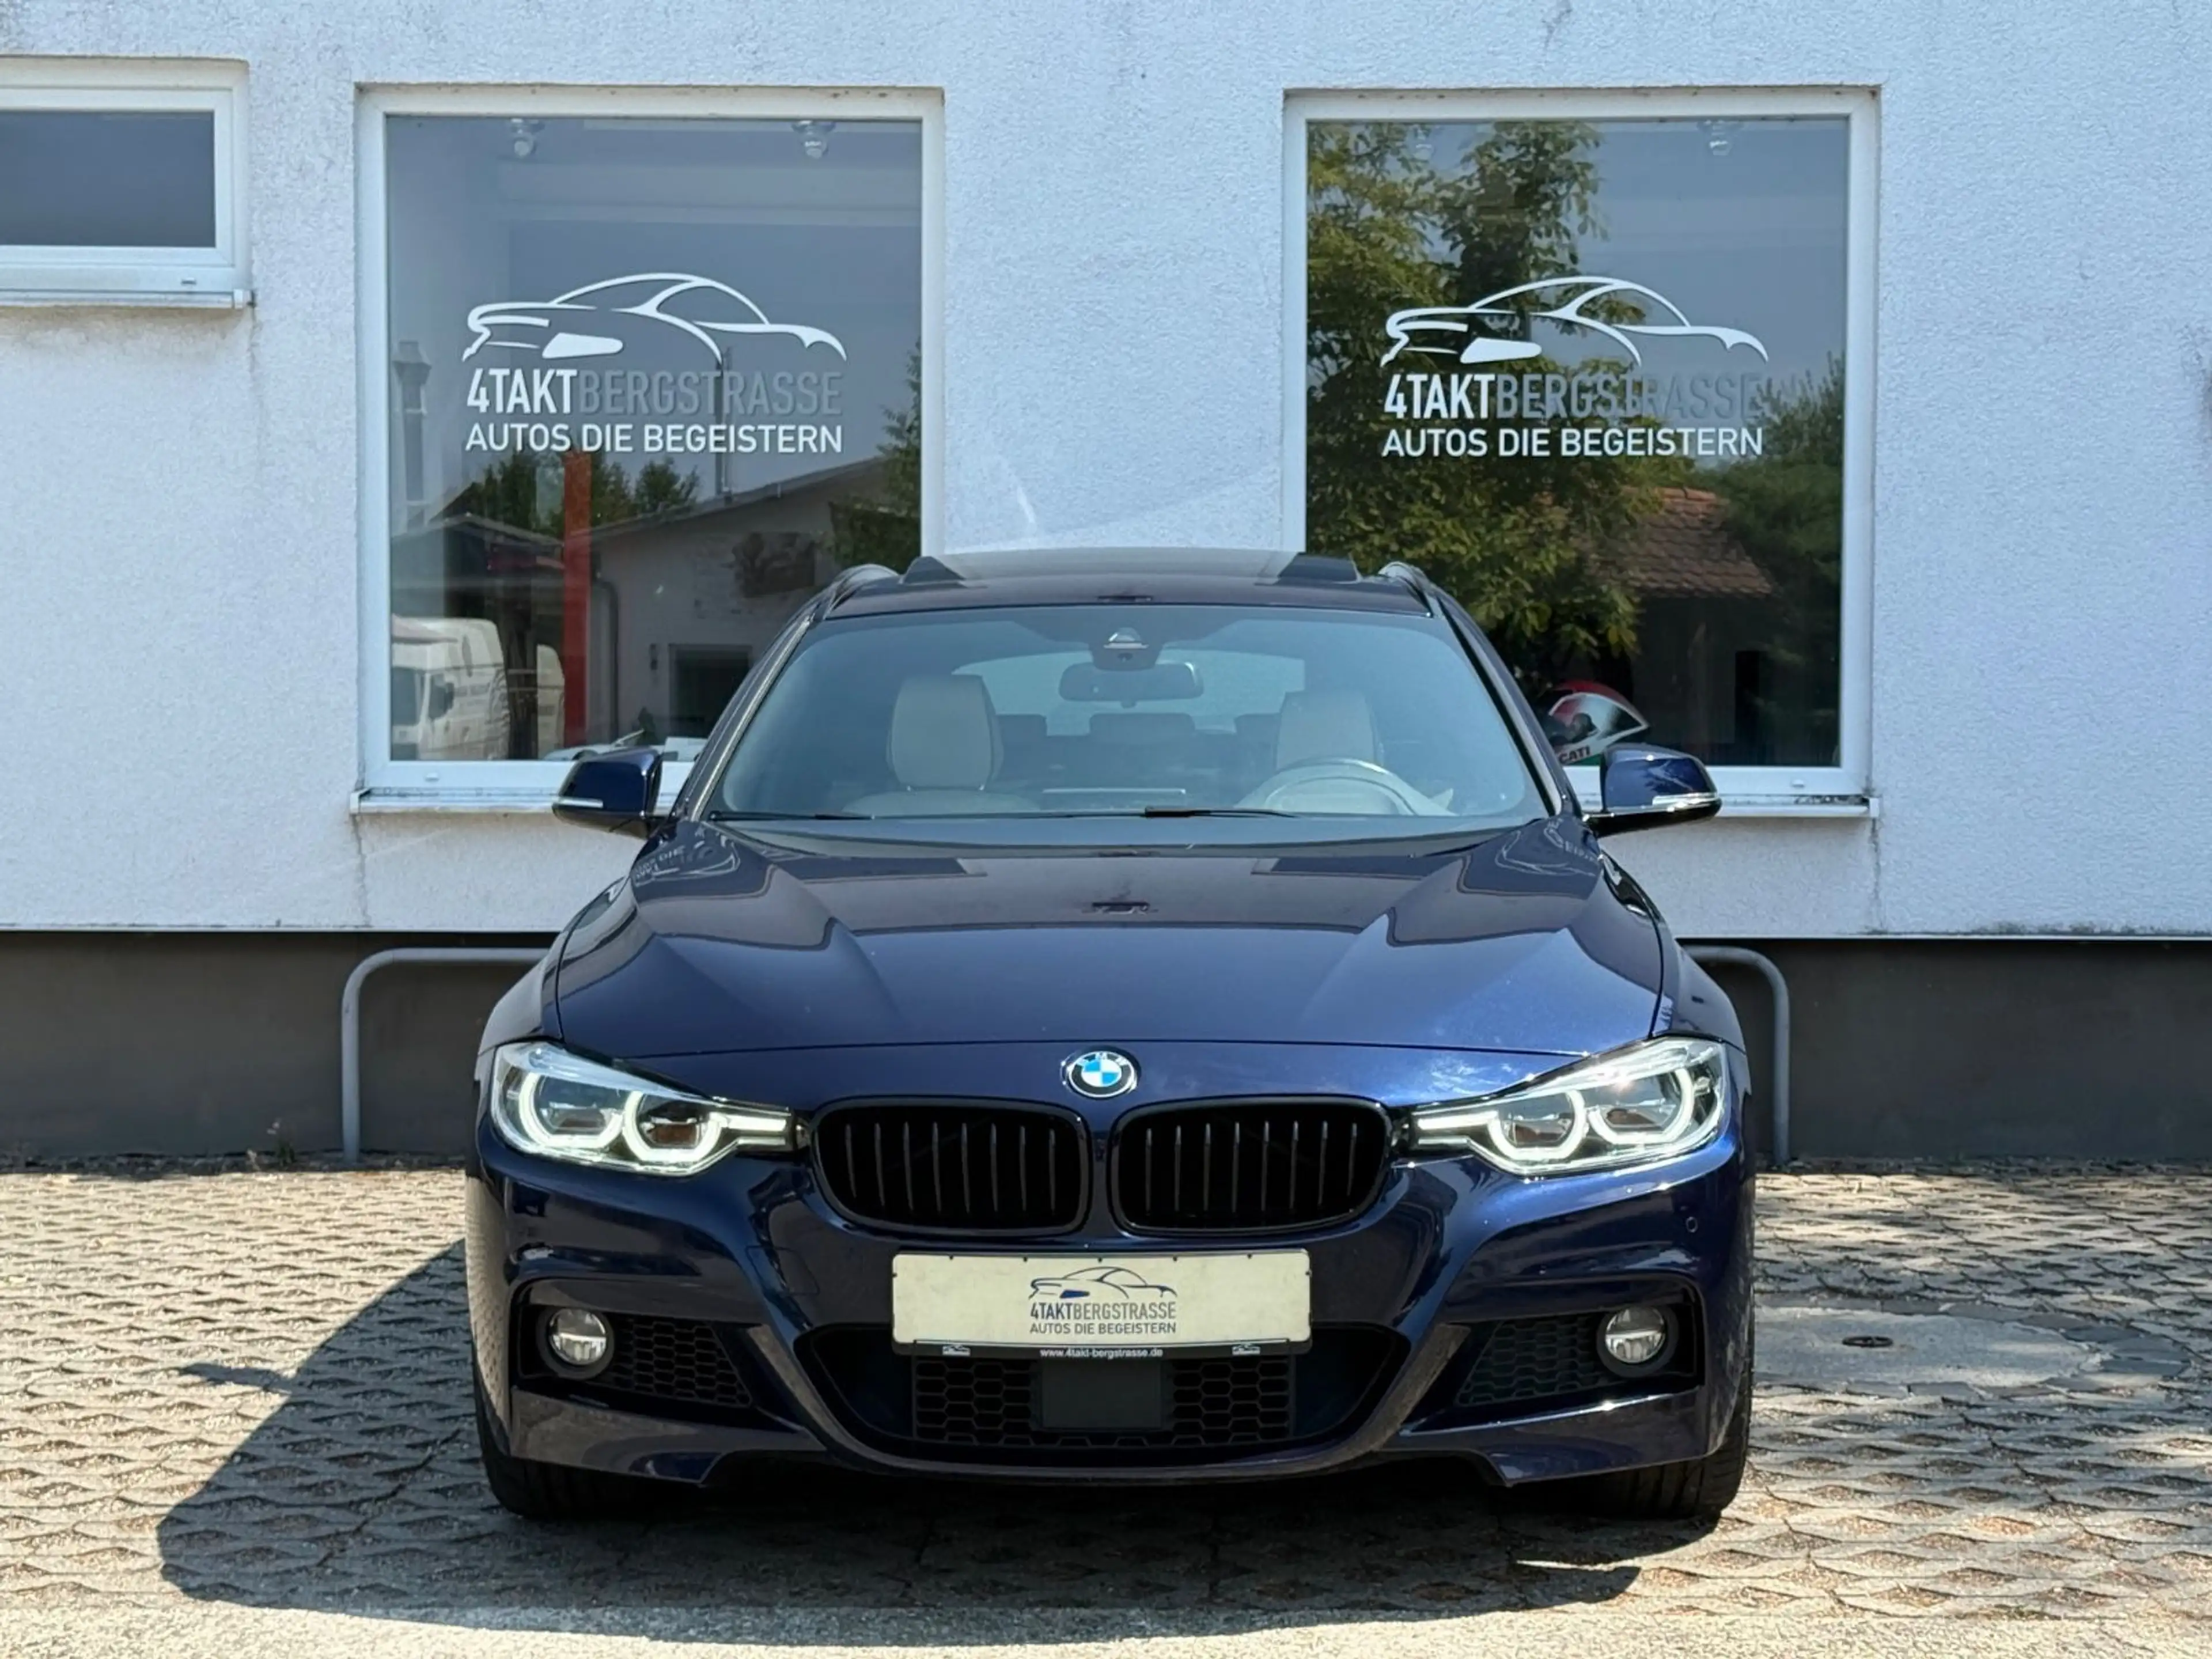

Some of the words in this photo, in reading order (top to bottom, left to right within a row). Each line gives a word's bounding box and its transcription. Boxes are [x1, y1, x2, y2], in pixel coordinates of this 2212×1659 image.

[466, 368, 843, 415] 4TAKTBERGSTRASSE
[1384, 373, 1764, 419] 4TAKTBERGSTRASSE
[465, 423, 571, 452] AUTOS
[582, 424, 633, 453] DIE
[643, 425, 843, 453] BEGEISTERN
[1382, 428, 1487, 457] AUTOS
[1498, 429, 1550, 457] DIE
[1560, 428, 1763, 457] BEGEISTERN
[1558, 744, 1590, 765] CATI
[1030, 1301, 1176, 1320] 4TAKTBERGSTRASSE
[1029, 1323, 1071, 1335] AUTOS
[1074, 1323, 1094, 1335] DIE
[1099, 1322, 1176, 1335] BEGEISTERN
[1039, 1348, 1163, 1359] www.4takt-bergstrasse.de
